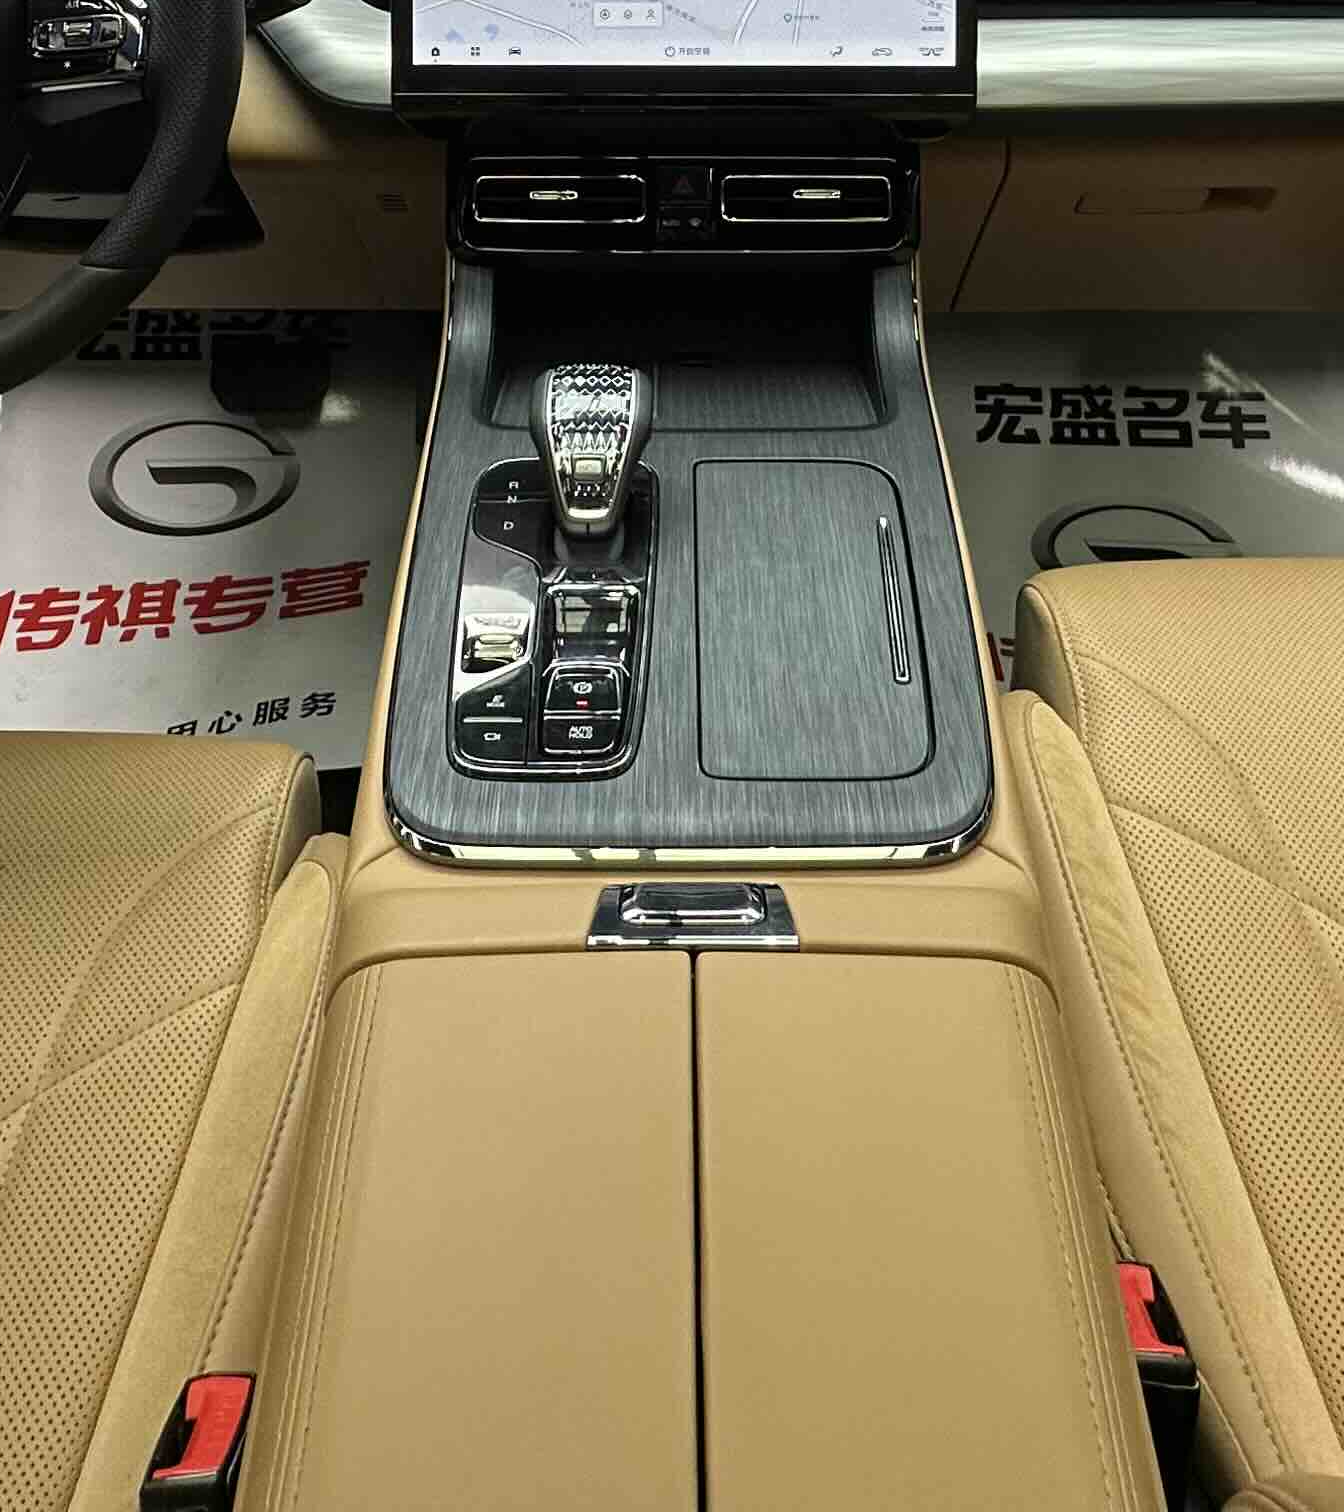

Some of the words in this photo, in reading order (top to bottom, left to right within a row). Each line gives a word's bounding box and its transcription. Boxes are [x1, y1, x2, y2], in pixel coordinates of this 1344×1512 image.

[973, 382, 1272, 449] 宏盛名车
[506, 495, 518, 504] N
[503, 520, 514, 531] D
[167, 691, 337, 737] 用心服务
